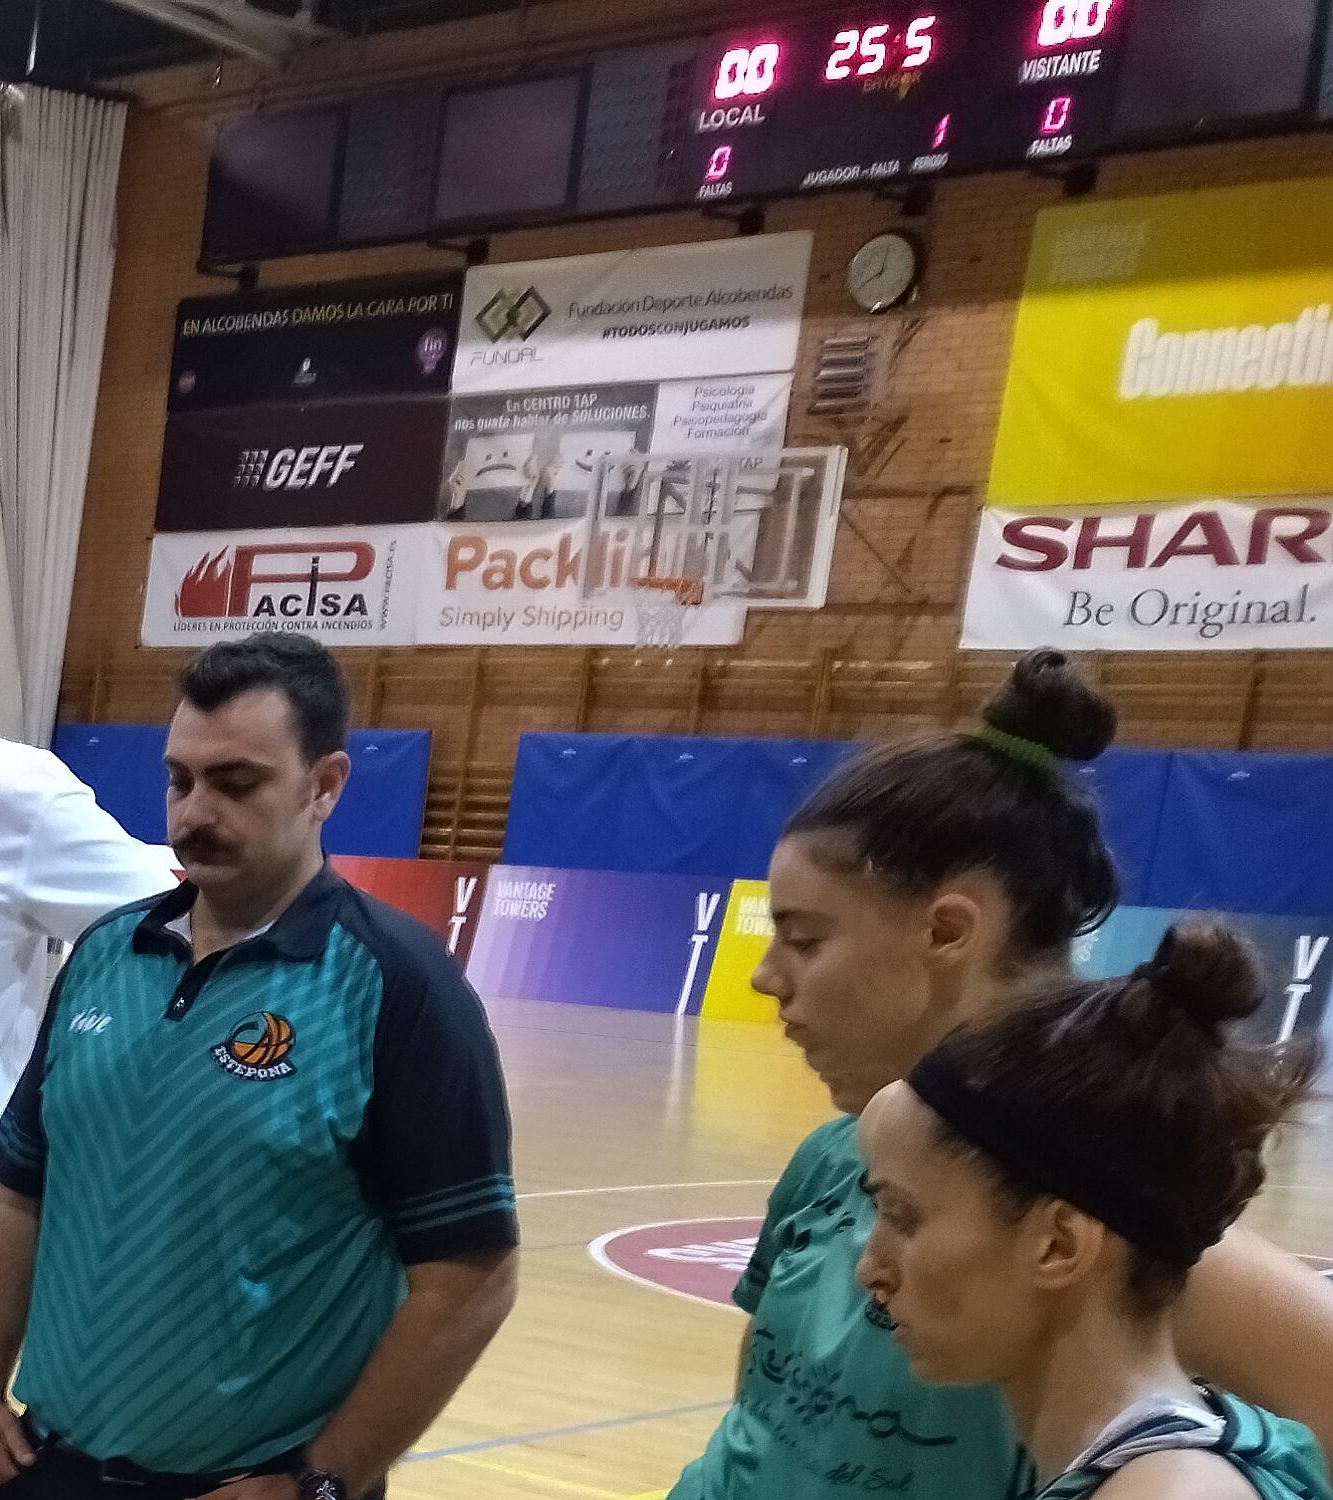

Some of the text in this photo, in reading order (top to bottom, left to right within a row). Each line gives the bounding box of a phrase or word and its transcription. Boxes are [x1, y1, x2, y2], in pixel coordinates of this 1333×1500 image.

[714, 43, 780, 99] 00
[1020, 50, 1102, 86] VISITANTE
[697, 104, 766, 133] LOCAL
[1041, 97, 1071, 132] 0
[933, 114, 950, 149] 1
[1029, 135, 1072, 158] FALTAS
[706, 146, 731, 181] 0
[802, 165, 859, 189] JUGADOR
[697, 182, 732, 201] FALTAS
[203, 309, 289, 334] ALCOBENDAS
[292, 303, 344, 325] DAMOS
[408, 295, 438, 313] POR
[642, 292, 705, 315] Deporte
[708, 285, 794, 305] Alcobendas
[470, 348, 544, 367] FUNDAL
[1119, 304, 1333, 401] Connecti
[573, 393, 597, 407] TAP
[264, 442, 364, 491] GEFF
[282, 621, 319, 631] CONTRA
[321, 620, 373, 631] INCENDIOS
[439, 606, 623, 632] Simply Shipping
[1062, 584, 1317, 639] Be Original.
[497, 881, 556, 902] VANTAGE
[493, 900, 549, 920] TOWERS
[213, 1045, 293, 1080] ESTEPONA
